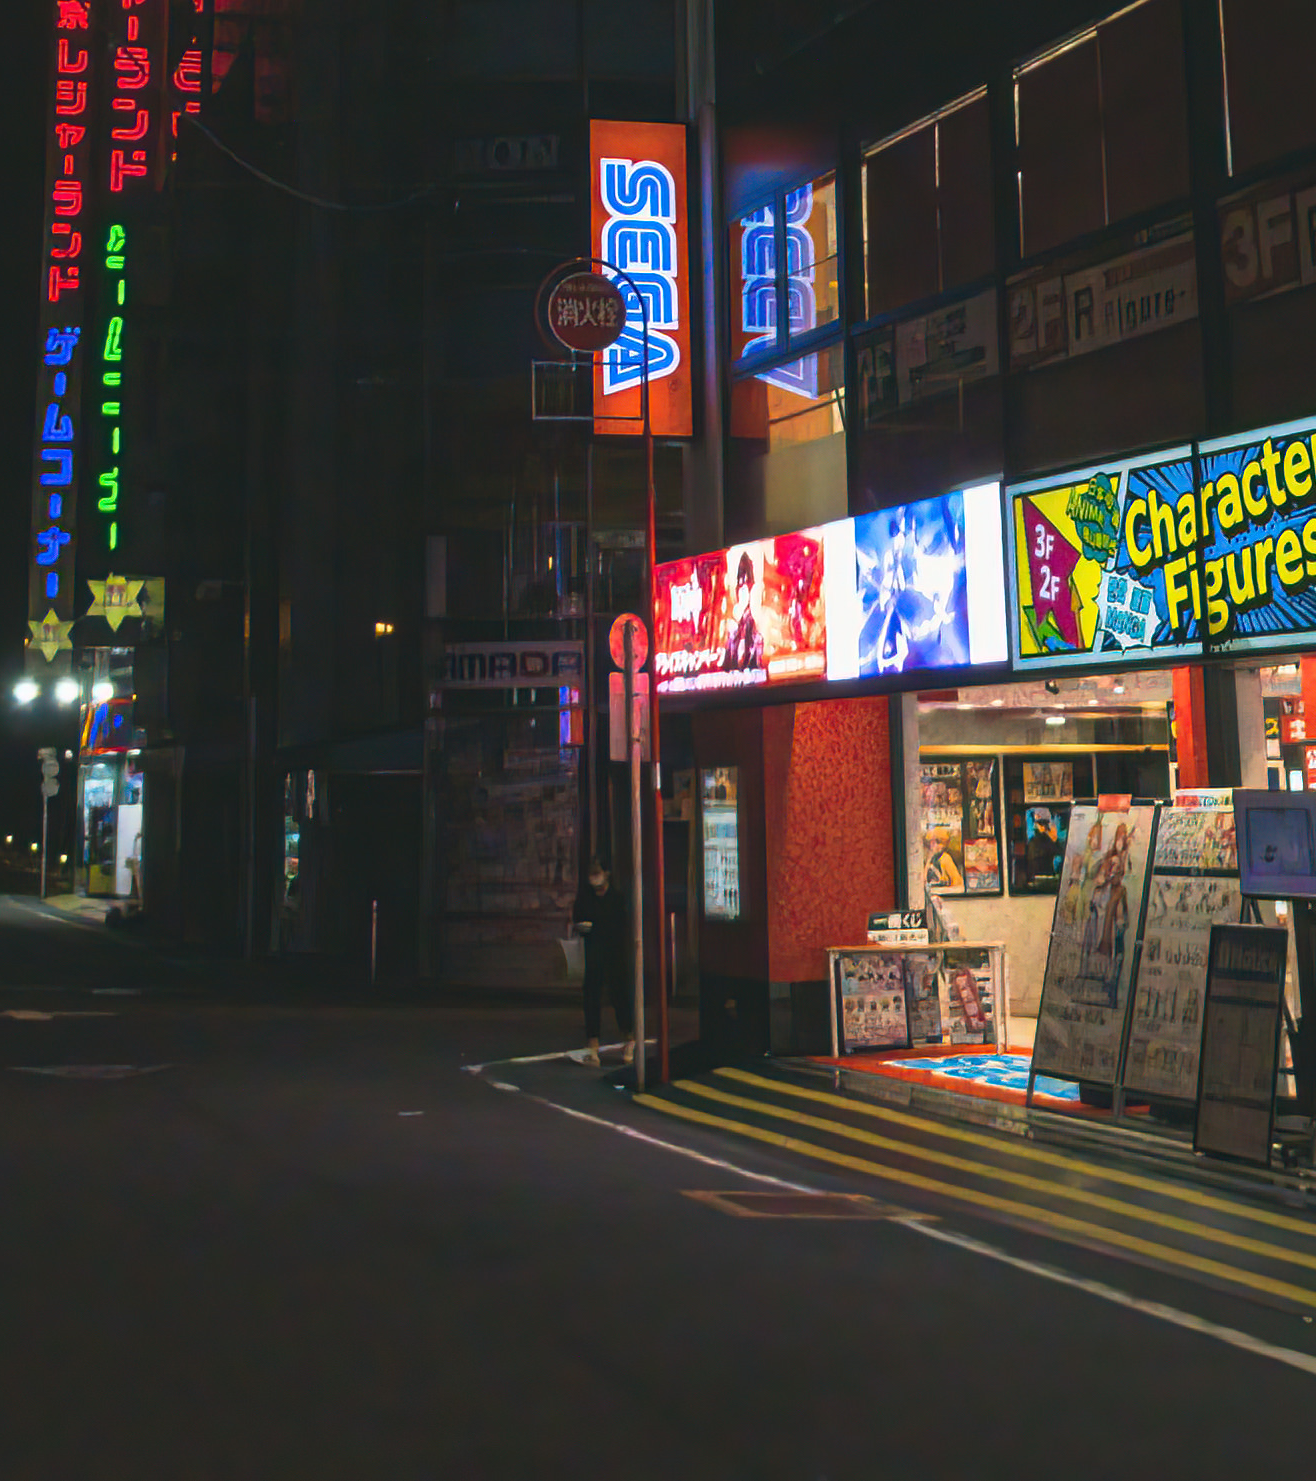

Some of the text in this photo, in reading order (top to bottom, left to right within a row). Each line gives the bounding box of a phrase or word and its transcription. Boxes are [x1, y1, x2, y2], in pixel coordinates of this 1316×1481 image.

[600, 157, 681, 396] SEGA
[1221, 201, 1295, 289] 3F
[557, 296, 617, 328] 消火栓
[36, 326, 81, 600] ゲームコーナー
[1034, 523, 1056, 560] 3F
[1039, 564, 1062, 603] 2F
